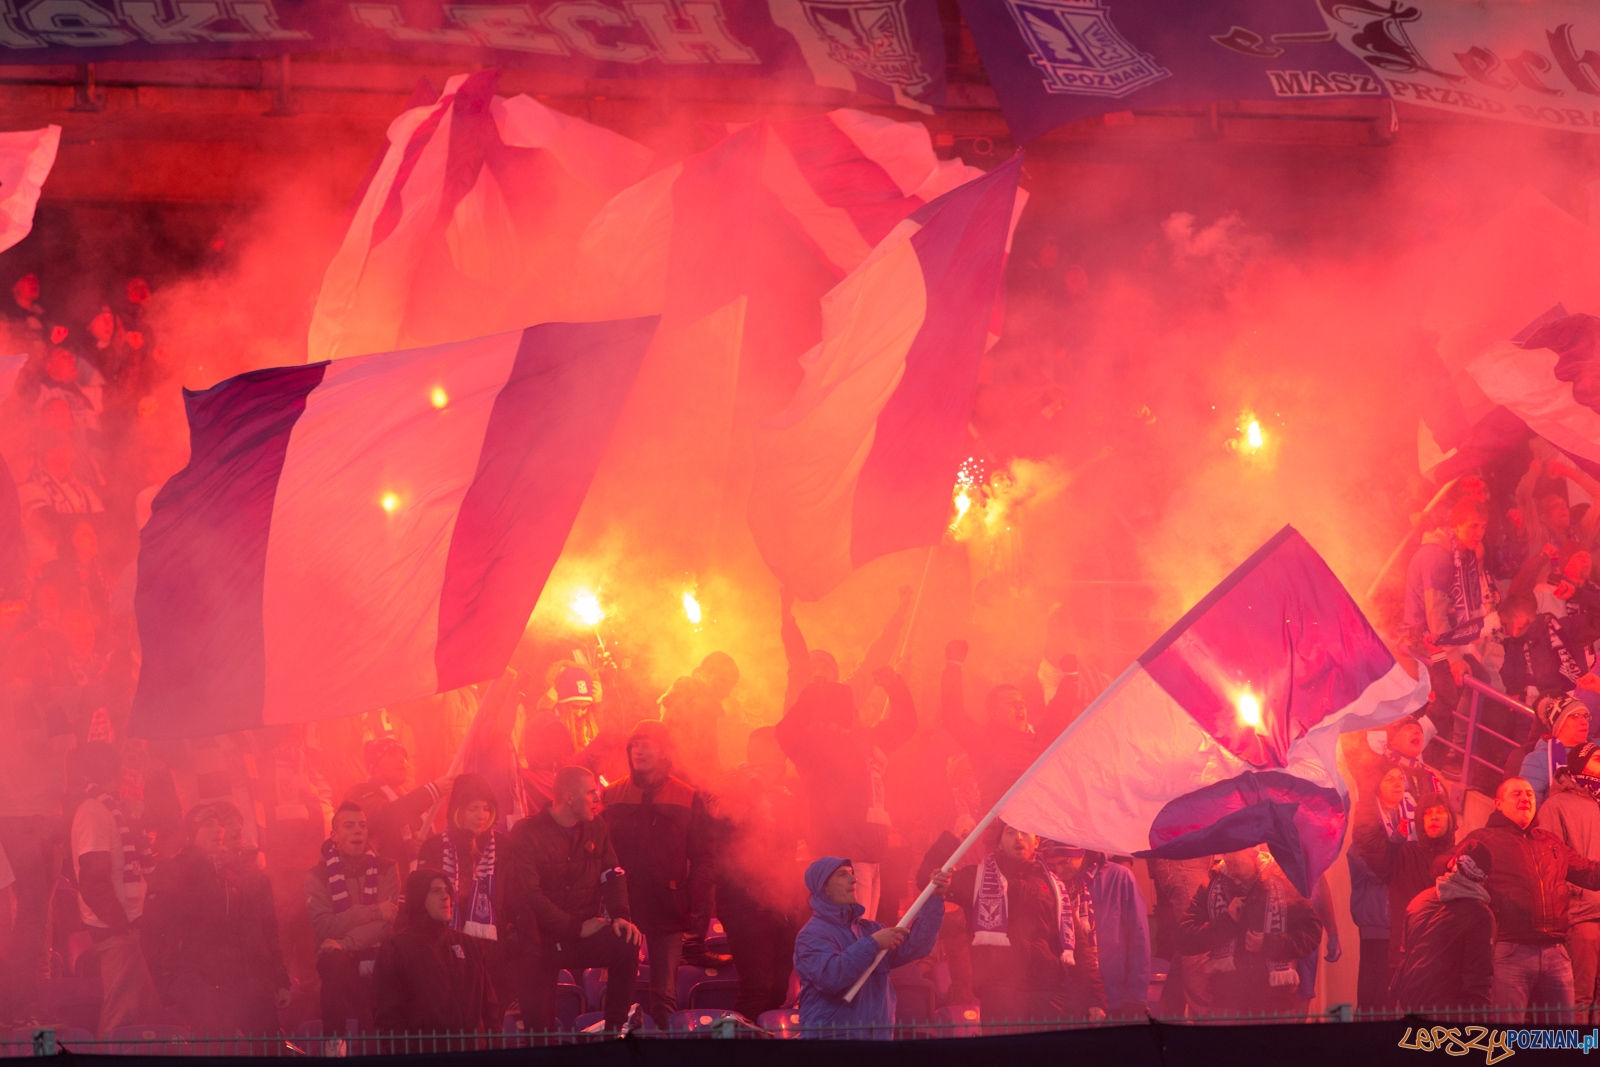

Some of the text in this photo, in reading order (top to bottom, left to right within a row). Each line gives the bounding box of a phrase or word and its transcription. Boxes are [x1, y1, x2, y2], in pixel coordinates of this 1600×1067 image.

[349, 0, 762, 65] LECH
[1267, 70, 1381, 96] MASZ
[1385, 79, 1507, 114] PRZED
